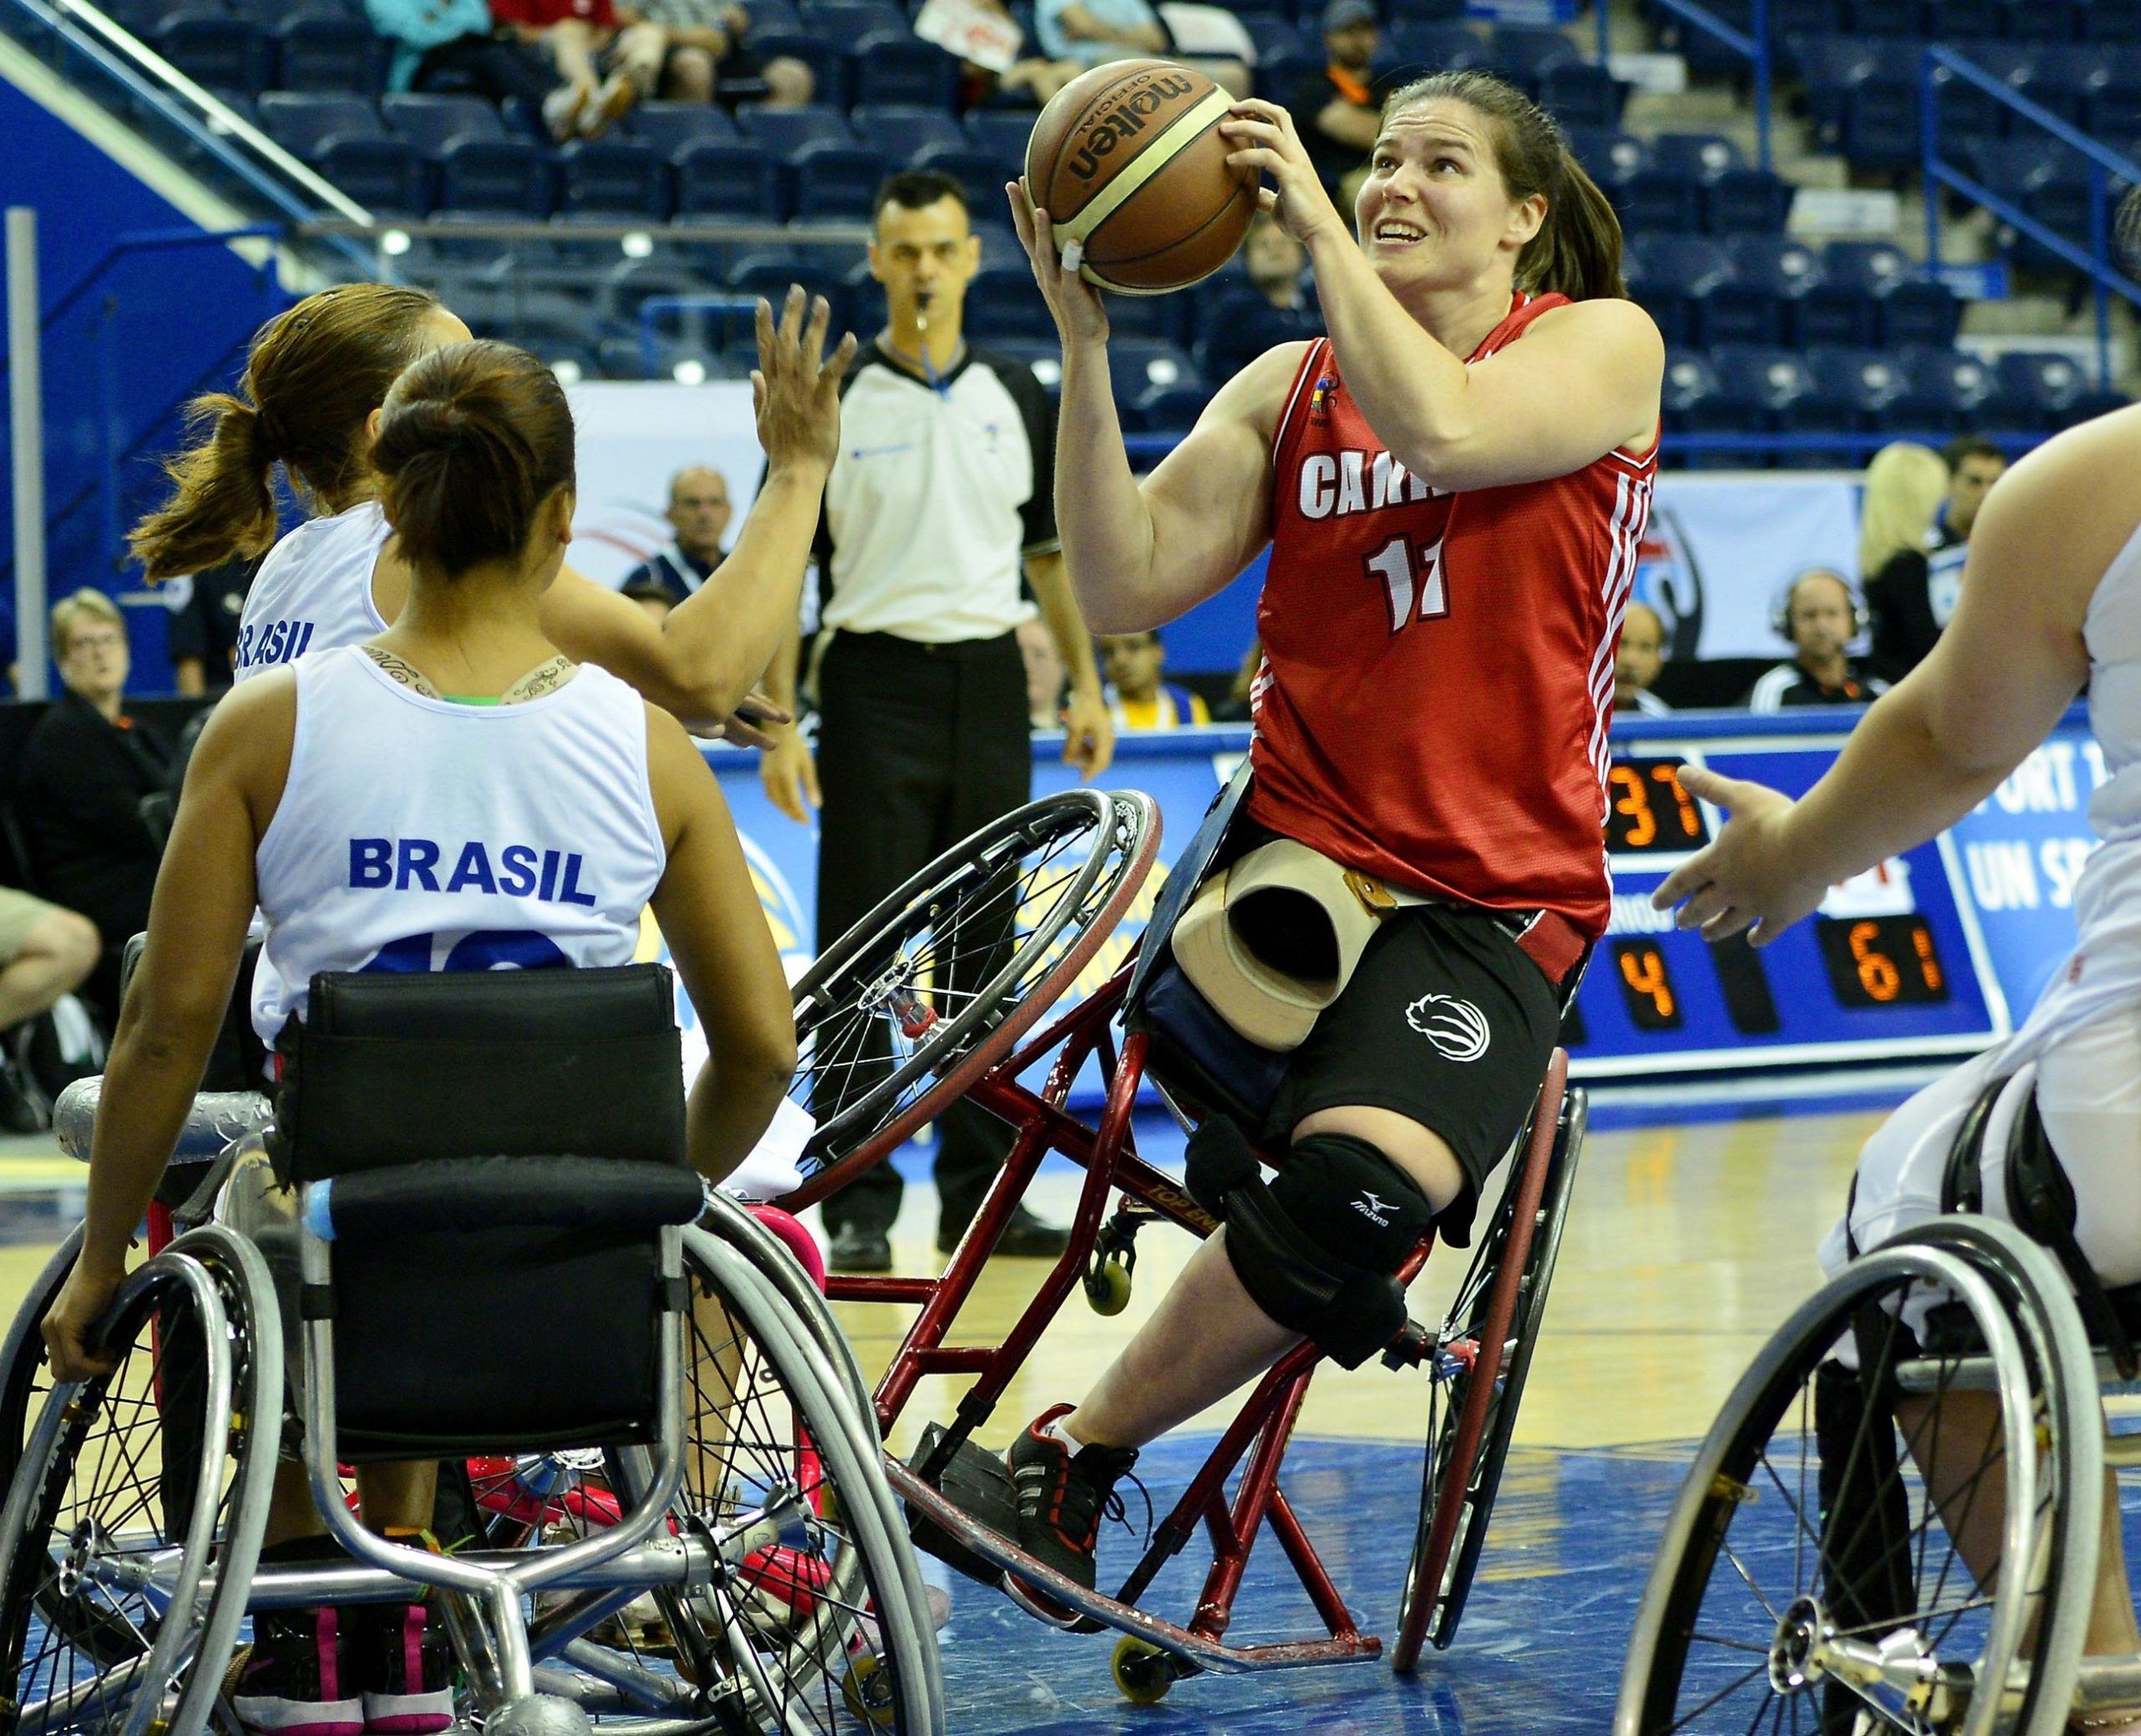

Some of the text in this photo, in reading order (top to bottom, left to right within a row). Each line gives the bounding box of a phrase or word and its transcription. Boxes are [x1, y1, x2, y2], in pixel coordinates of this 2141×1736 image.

[1070, 74, 1193, 181] molten
[1075, 75, 1152, 137] OFFICIAL
[1368, 538, 1445, 632] 11
[1610, 764, 1700, 846] 37
[1974, 741, 2078, 814] ORT
[349, 838, 596, 907] BRASIL
[1967, 838, 2103, 911] UN SP
[1620, 951, 1673, 1017] 4
[1849, 922, 1942, 1002] 61
[1350, 1201, 1389, 1228] MIZUNO
